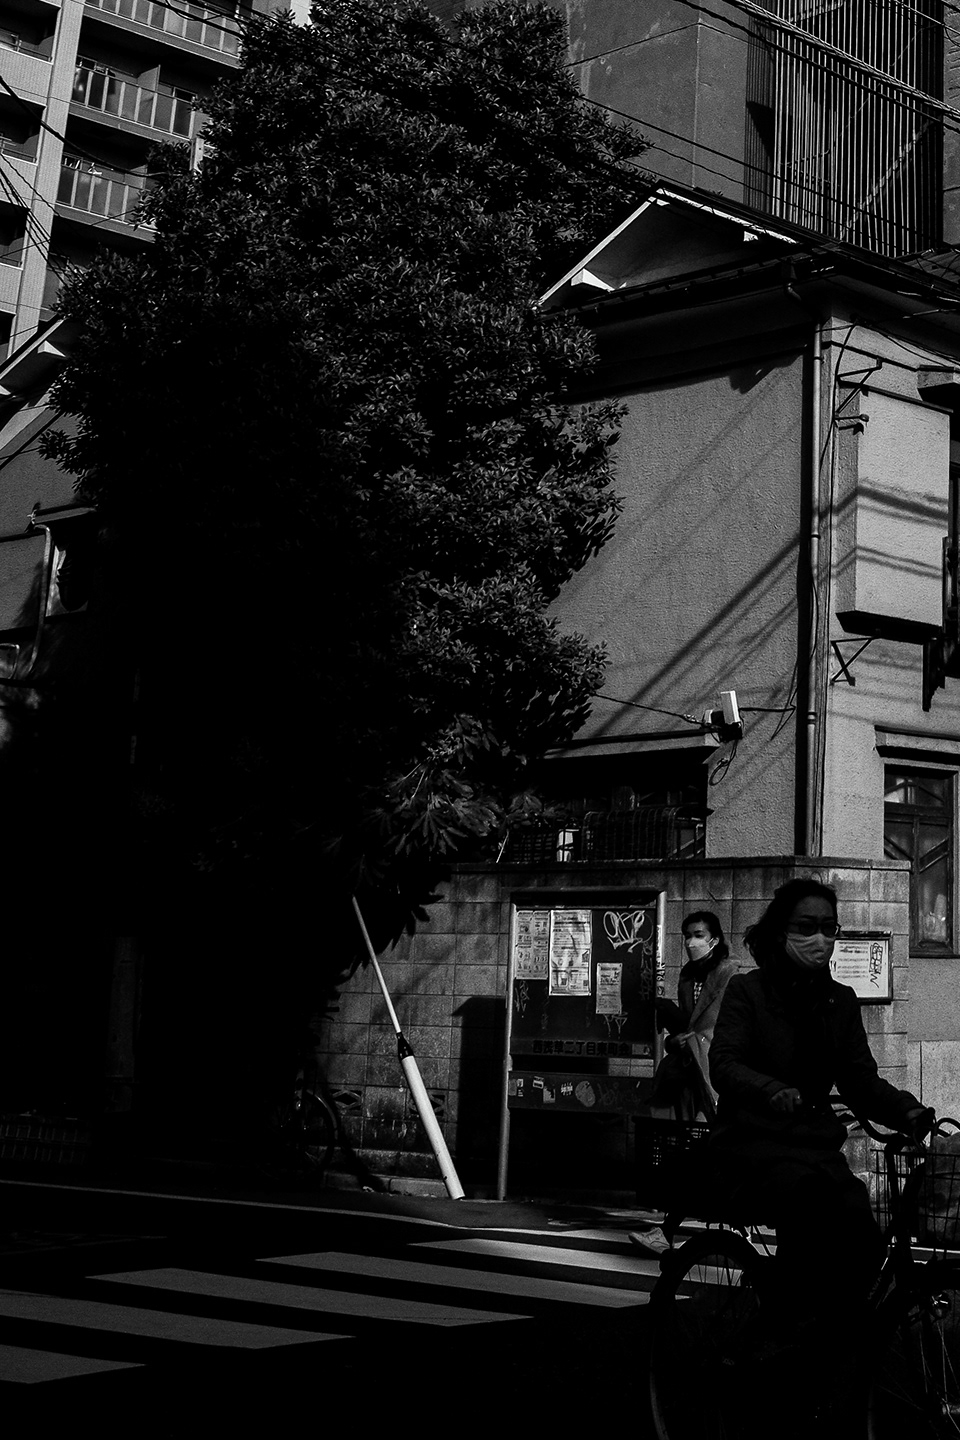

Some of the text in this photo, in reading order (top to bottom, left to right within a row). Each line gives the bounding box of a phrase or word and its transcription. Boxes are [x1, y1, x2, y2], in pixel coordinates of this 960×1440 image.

[533, 1040, 629, 1056] 西浅草二丁目東町会
